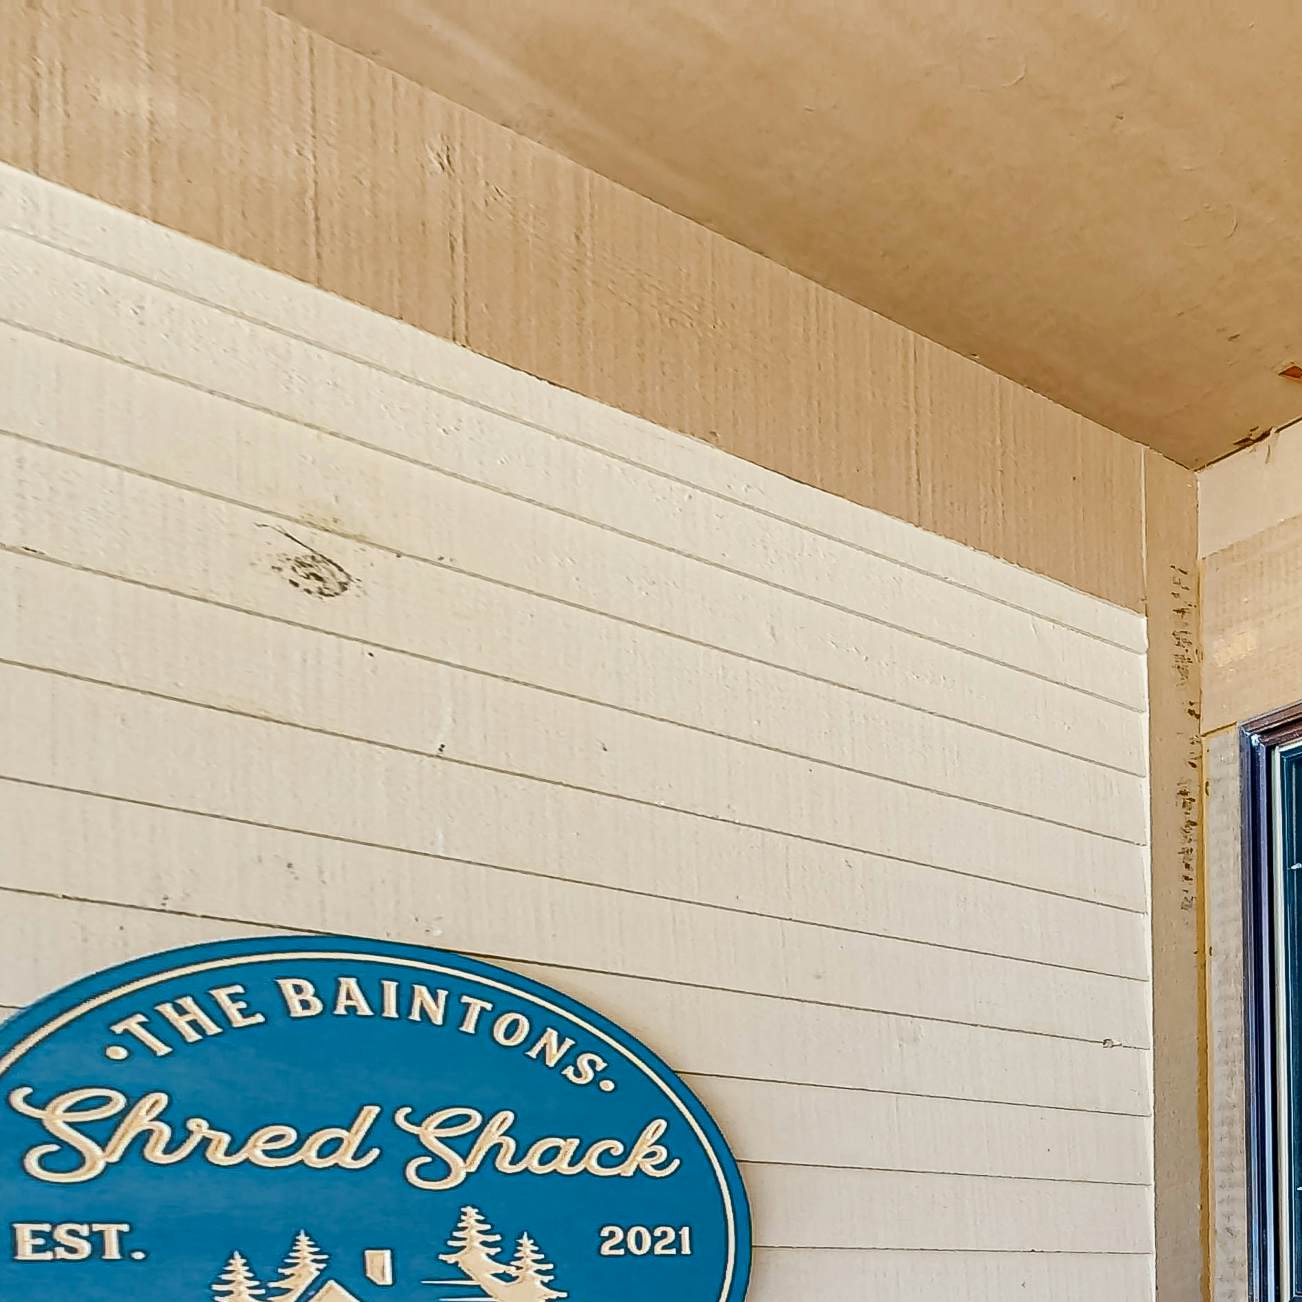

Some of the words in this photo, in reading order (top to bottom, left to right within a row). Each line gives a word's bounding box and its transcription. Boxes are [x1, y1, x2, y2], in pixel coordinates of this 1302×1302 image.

[109, 984, 266, 1057] THE
[8, 1085, 382, 1184] Shred
[393, 1106, 682, 1191] Shack
[12, 1222, 147, 1263] EST.
[598, 1225, 694, 1257] 2021
